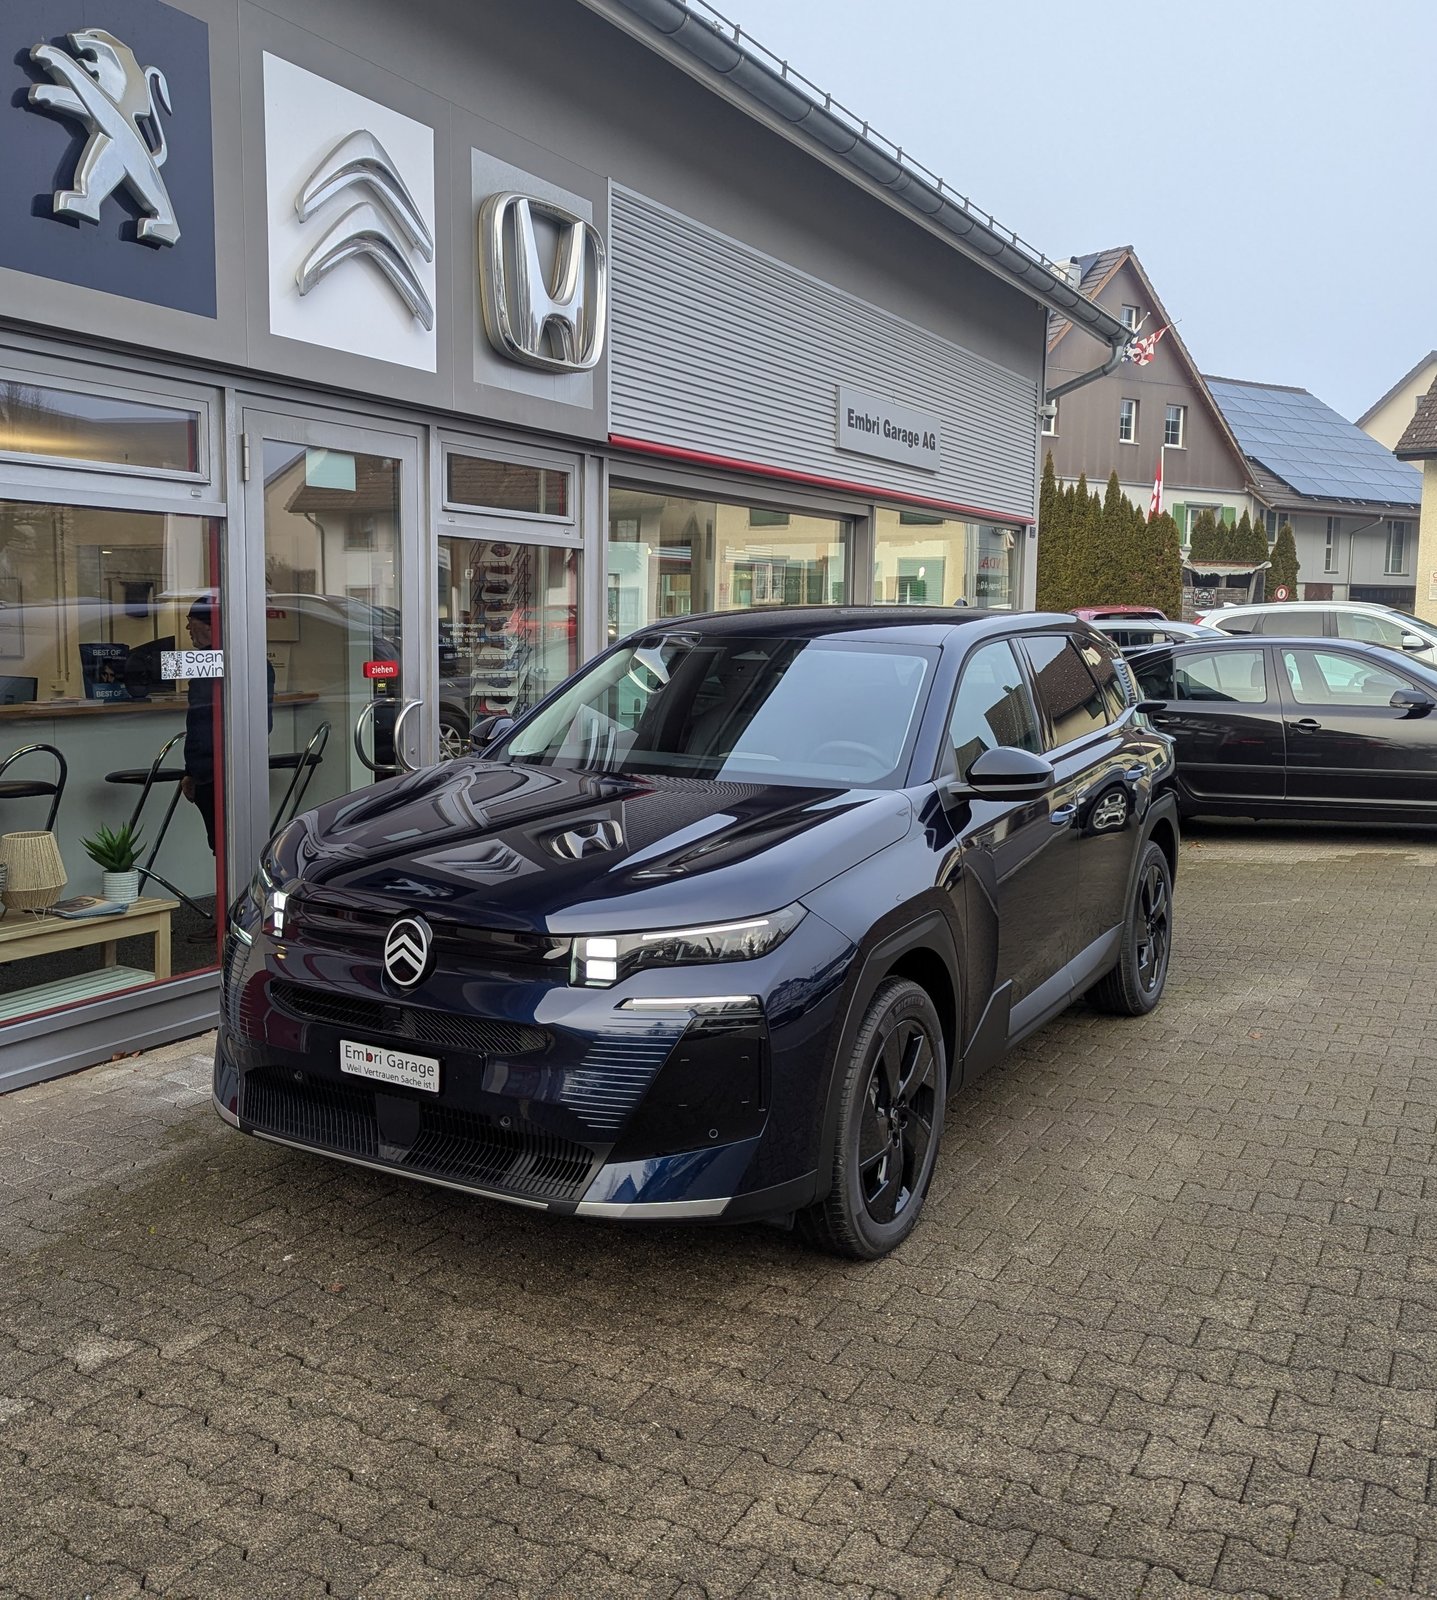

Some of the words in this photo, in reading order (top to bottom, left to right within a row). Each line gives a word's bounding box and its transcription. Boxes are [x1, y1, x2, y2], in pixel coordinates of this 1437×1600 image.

[847, 407, 880, 435] Embri
[883, 419, 920, 449] Garage
[922, 431, 936, 451] AG
[185, 651, 223, 664] Scan
[185, 667, 195, 677] &
[196, 663, 224, 677] Win
[371, 664, 394, 674] ziehen
[95, 690, 113, 698] BEST
[345, 1045, 382, 1065] Embri
[386, 1053, 435, 1078] Garage
[346, 1063, 362, 1073] Weil
[363, 1066, 400, 1081] Vertrauen
[400, 1074, 422, 1088] Sache
